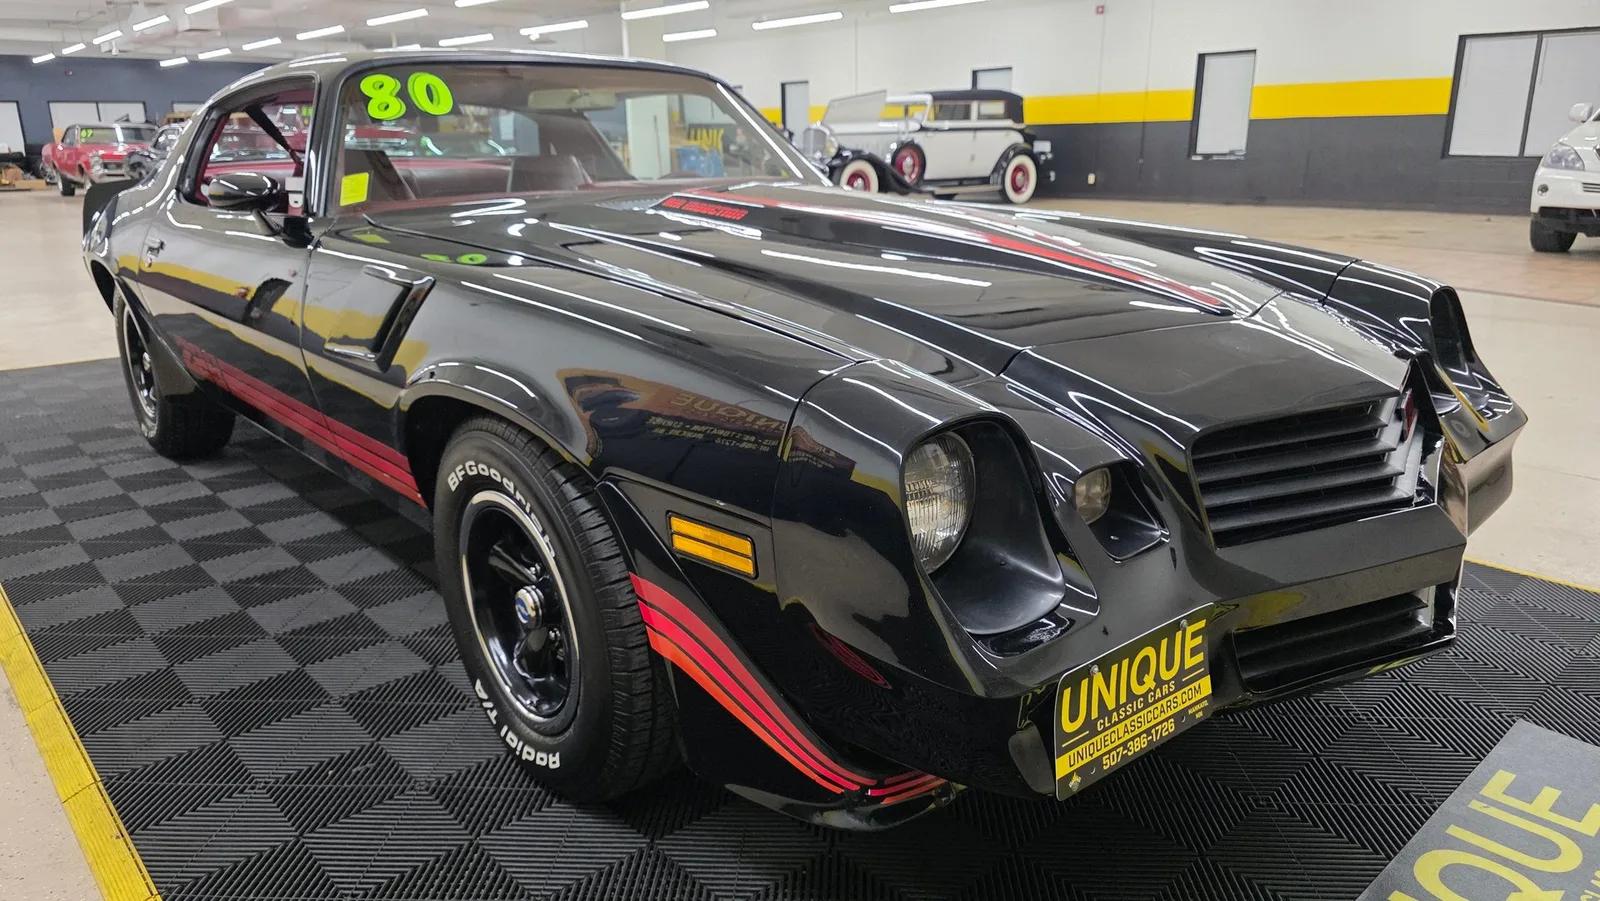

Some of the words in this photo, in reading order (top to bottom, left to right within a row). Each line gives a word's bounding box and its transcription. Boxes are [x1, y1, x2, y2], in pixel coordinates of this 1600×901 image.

[360, 71, 454, 121] 80
[1061, 618, 1207, 734] UNIQUE
[1096, 697, 1144, 732] CLASSIC
[1148, 680, 1176, 702] CARS
[1067, 682, 1203, 768] UNIQUECLASSICCARS.COM
[1102, 719, 1175, 770] 507-386-1726
[1387, 769, 1600, 901] QUE
